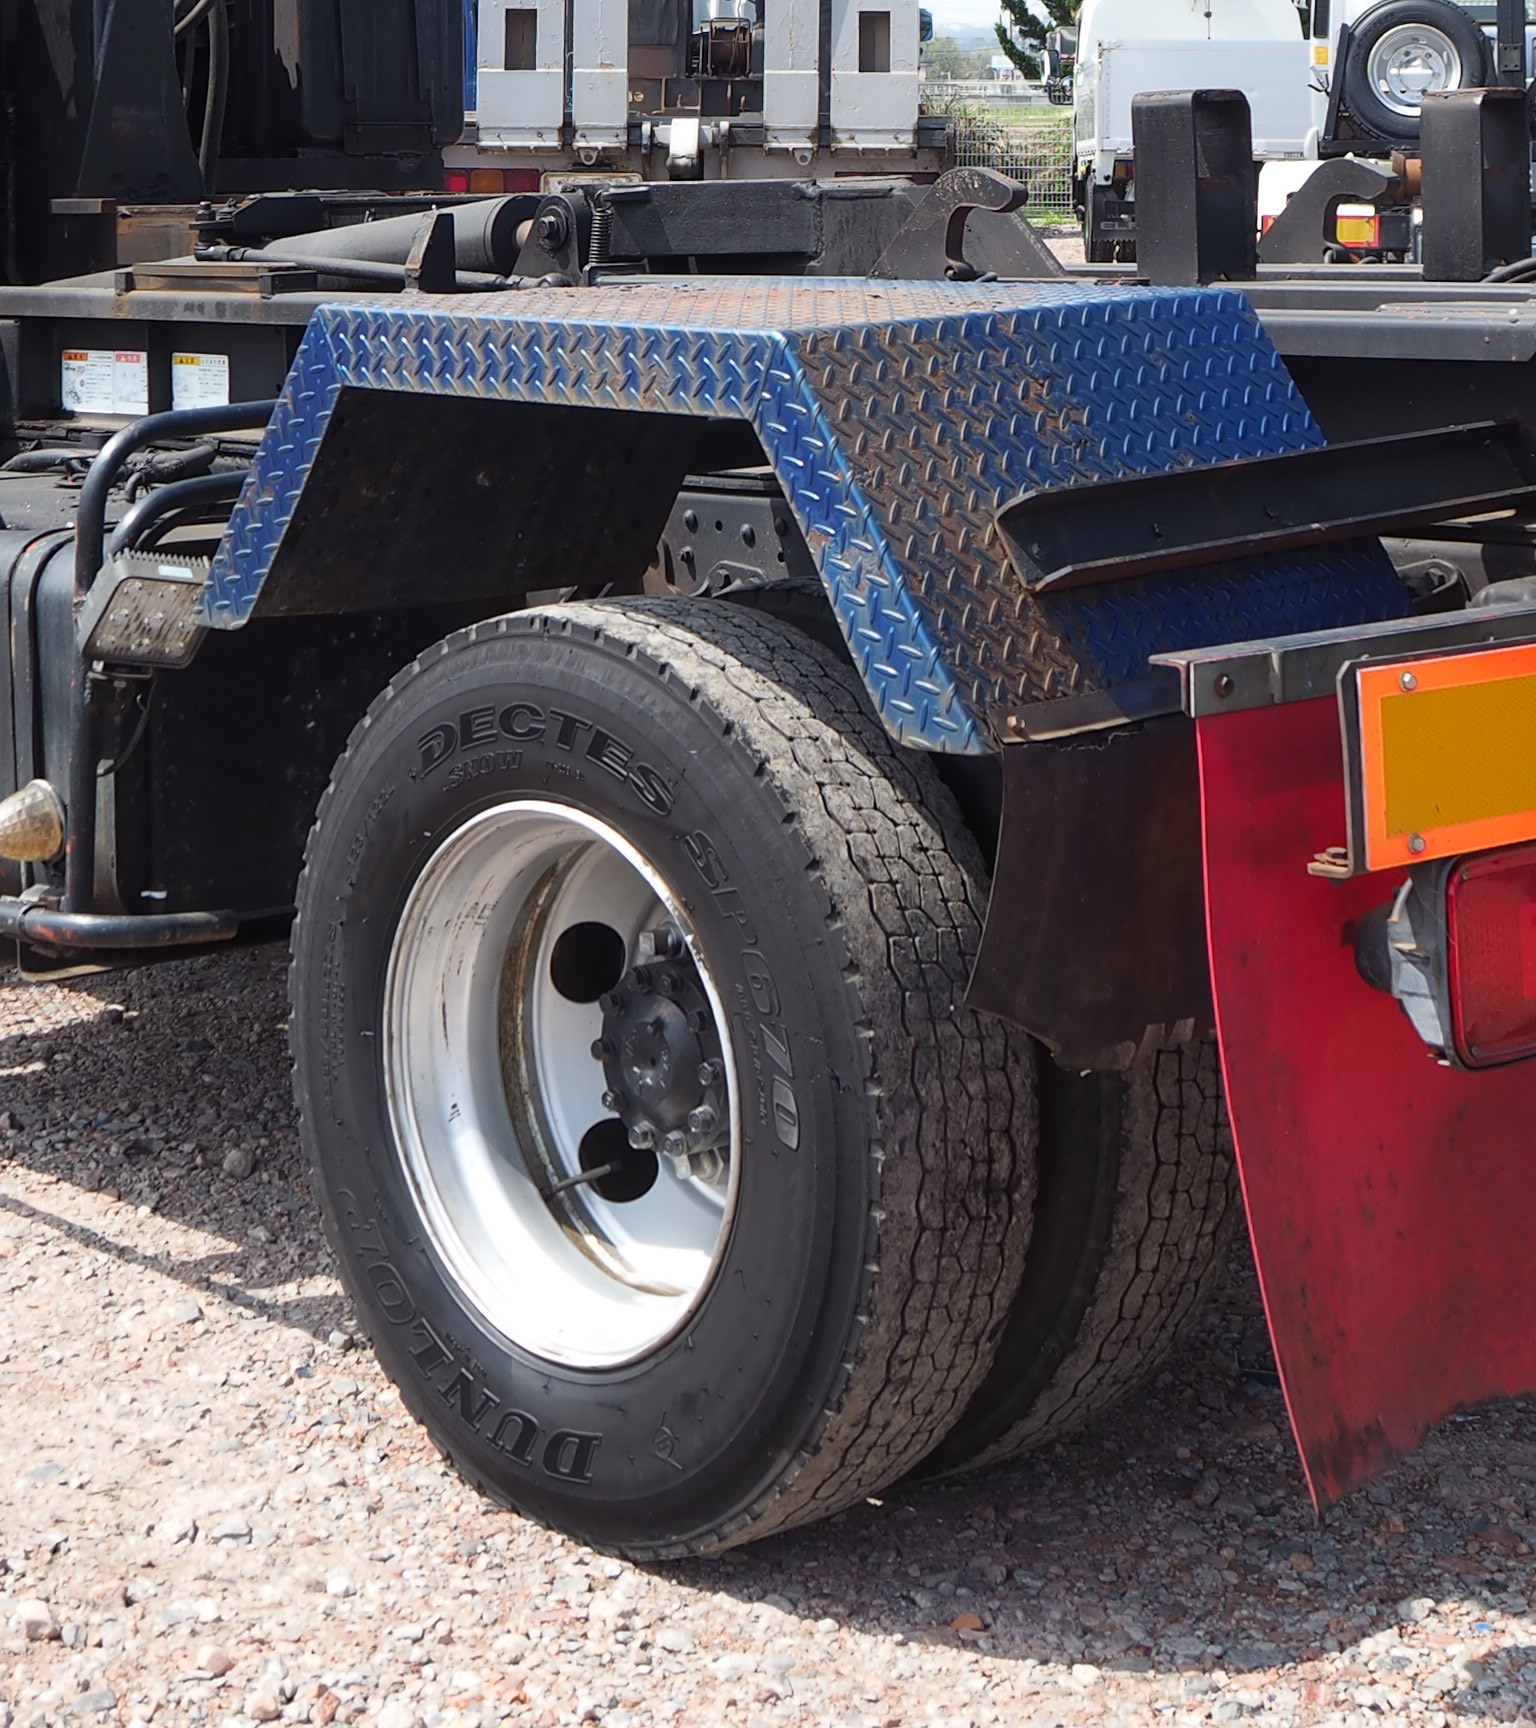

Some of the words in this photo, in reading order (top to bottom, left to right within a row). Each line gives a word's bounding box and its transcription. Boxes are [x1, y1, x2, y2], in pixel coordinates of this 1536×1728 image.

[448, 750, 524, 790] SNOW
[418, 701, 676, 817] DECTES
[683, 829, 801, 1152] SP670
[336, 1189, 603, 1485] DUNLOP
